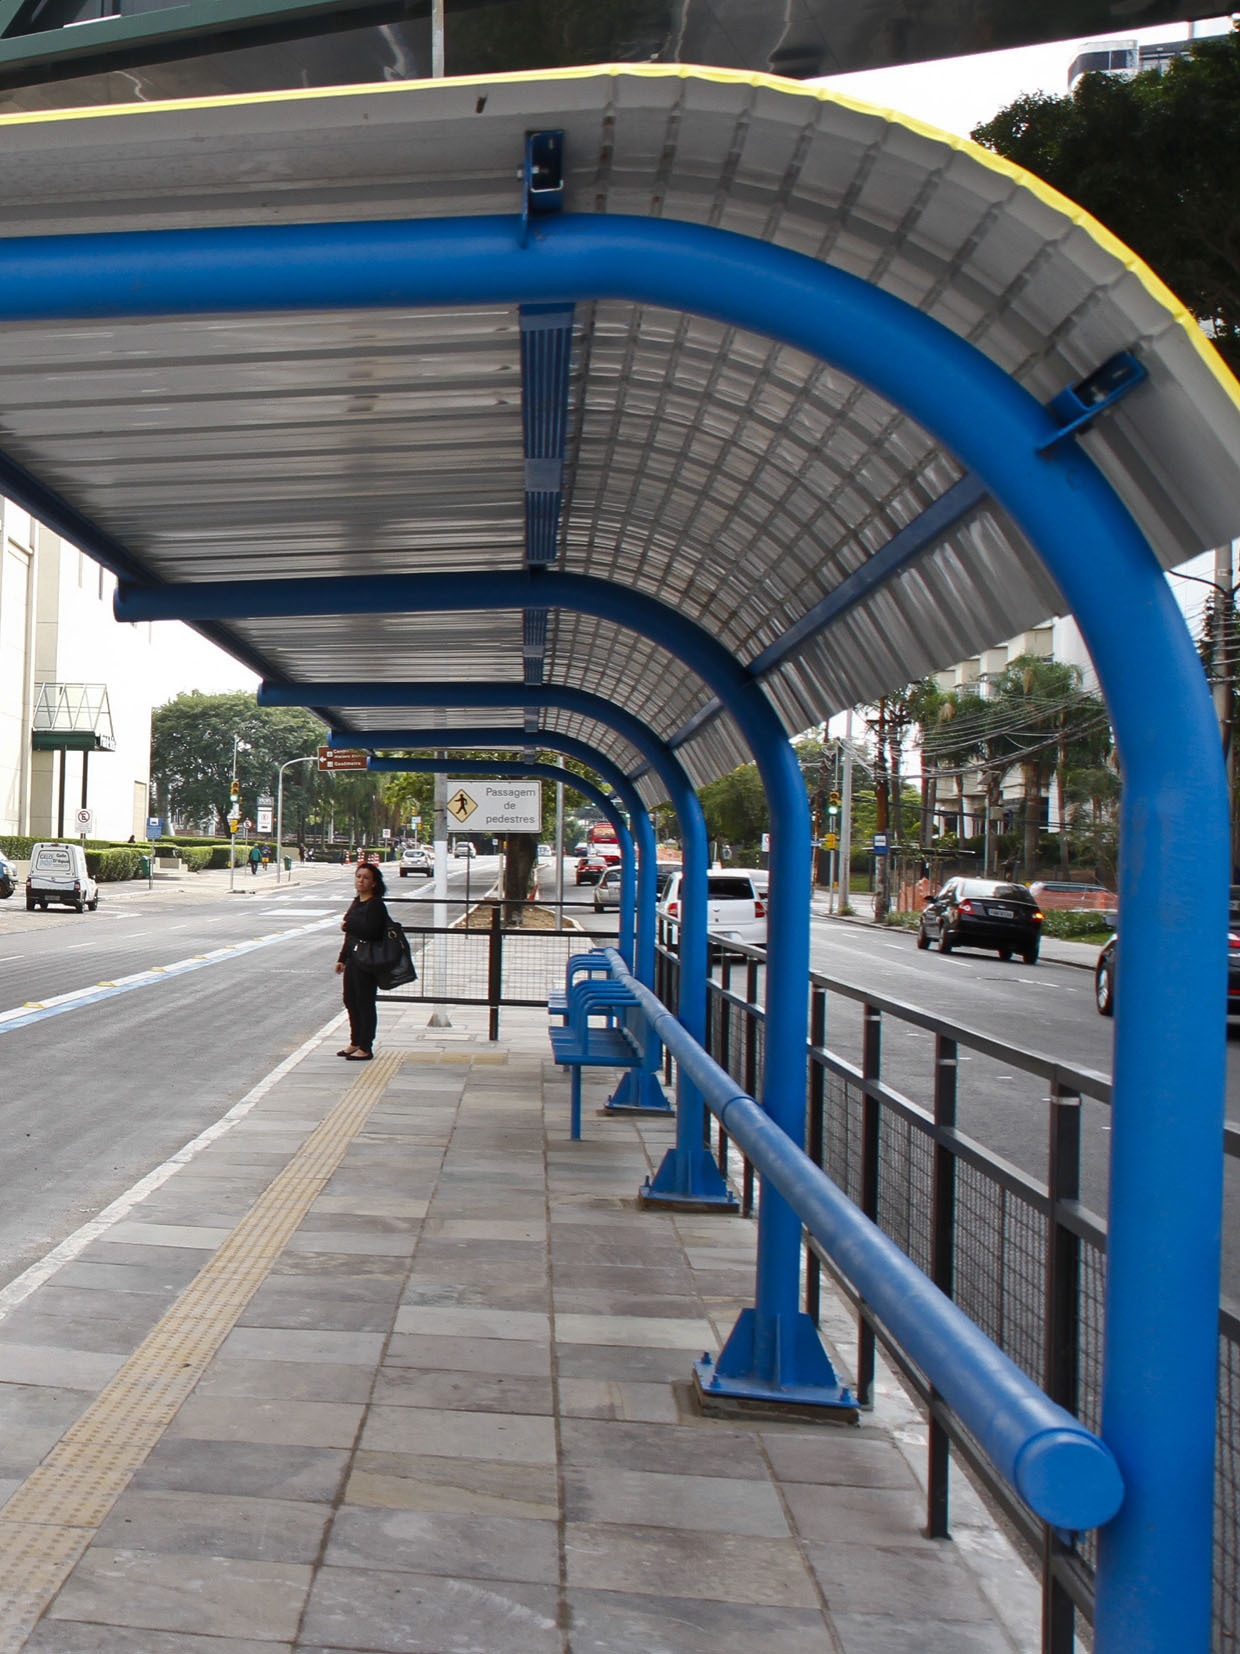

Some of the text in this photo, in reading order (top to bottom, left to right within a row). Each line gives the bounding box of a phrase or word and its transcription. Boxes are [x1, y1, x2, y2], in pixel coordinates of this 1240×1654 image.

[486, 787, 536, 799] Passagem
[504, 801, 516, 810] de
[486, 815, 535, 825] pedestres
